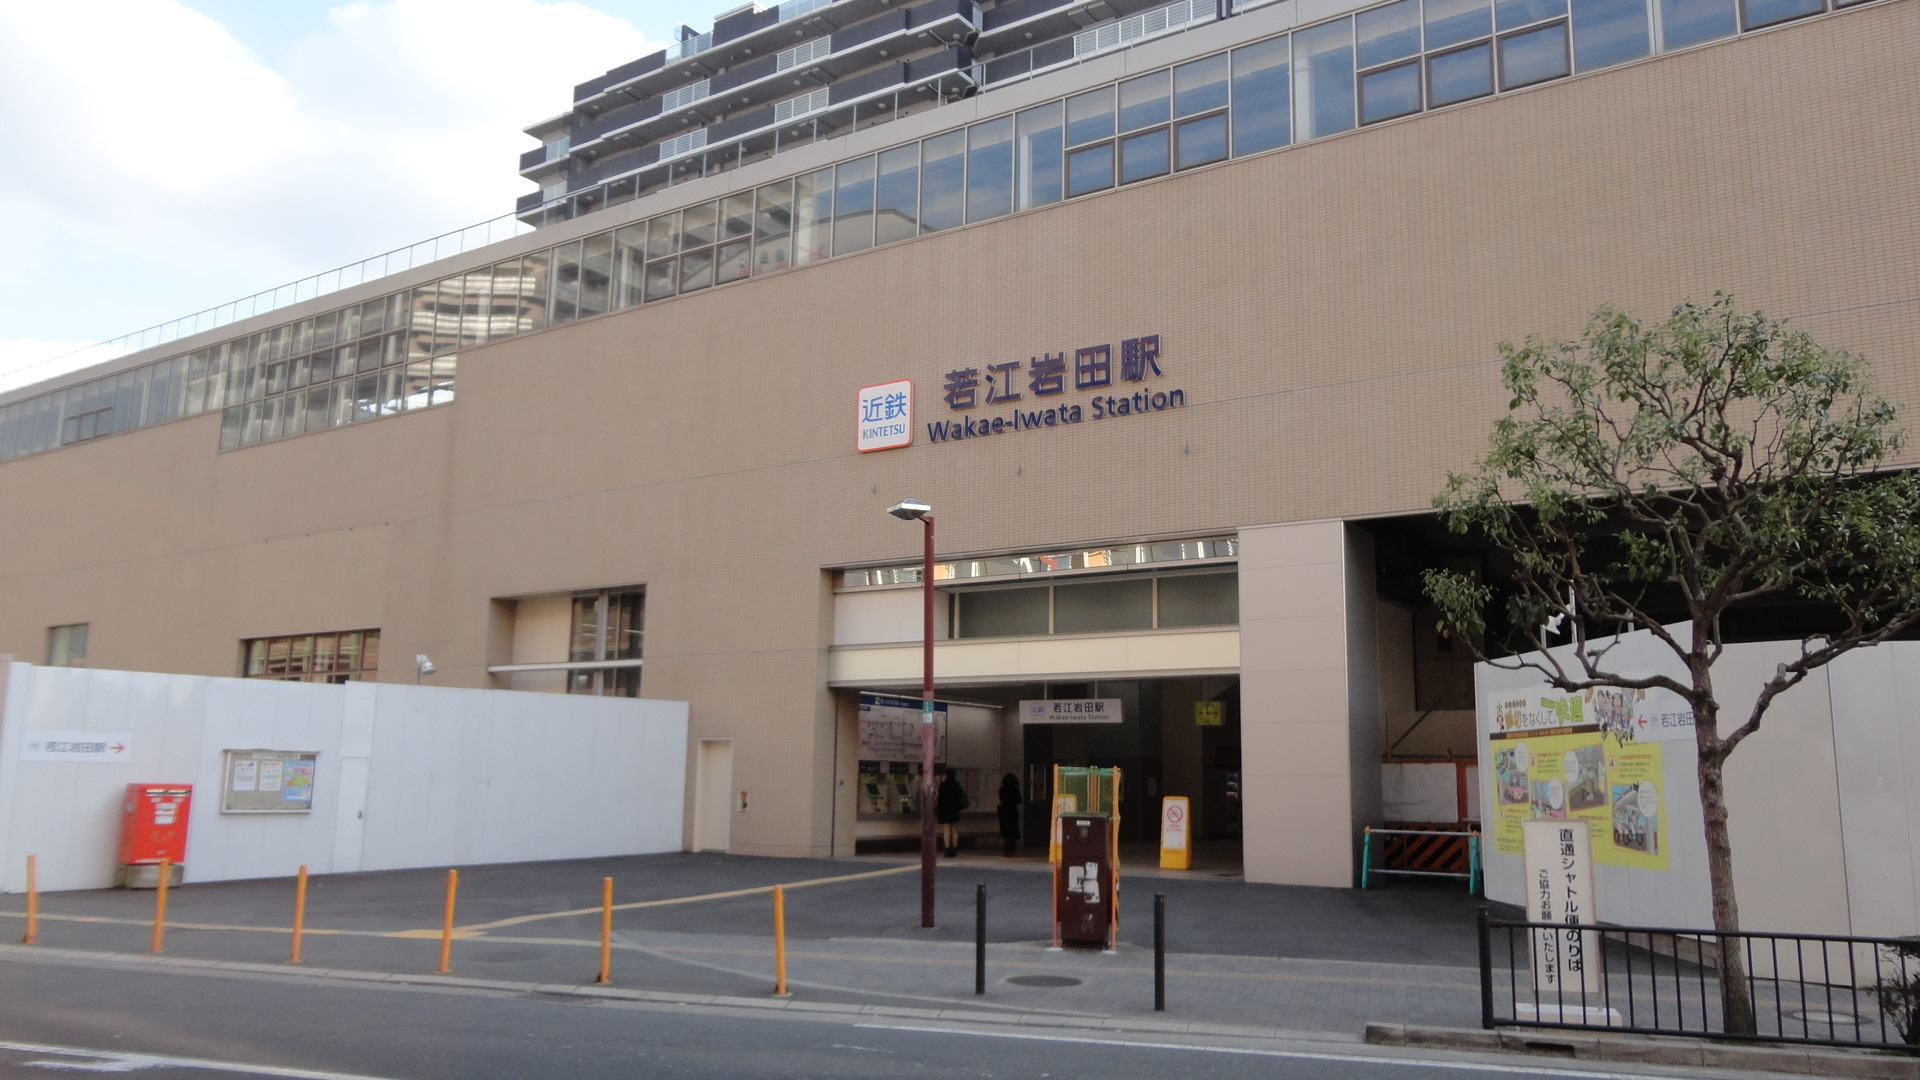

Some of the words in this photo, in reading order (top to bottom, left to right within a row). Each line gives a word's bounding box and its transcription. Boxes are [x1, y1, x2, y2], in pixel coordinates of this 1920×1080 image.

[943, 334, 1163, 410] 若江岩田駅
[862, 391, 907, 424] 近鉄
[927, 403, 1083, 443] Wakae-Iwata
[1092, 386, 1186, 421] Station
[862, 424, 906, 440] KINTETSU
[1053, 702, 1105, 713] 若江岩田駅
[1088, 713, 1110, 721] Station
[44, 741, 107, 754] 若江岩田駅
[1538, 868, 1556, 985] ご協力お願いたします
